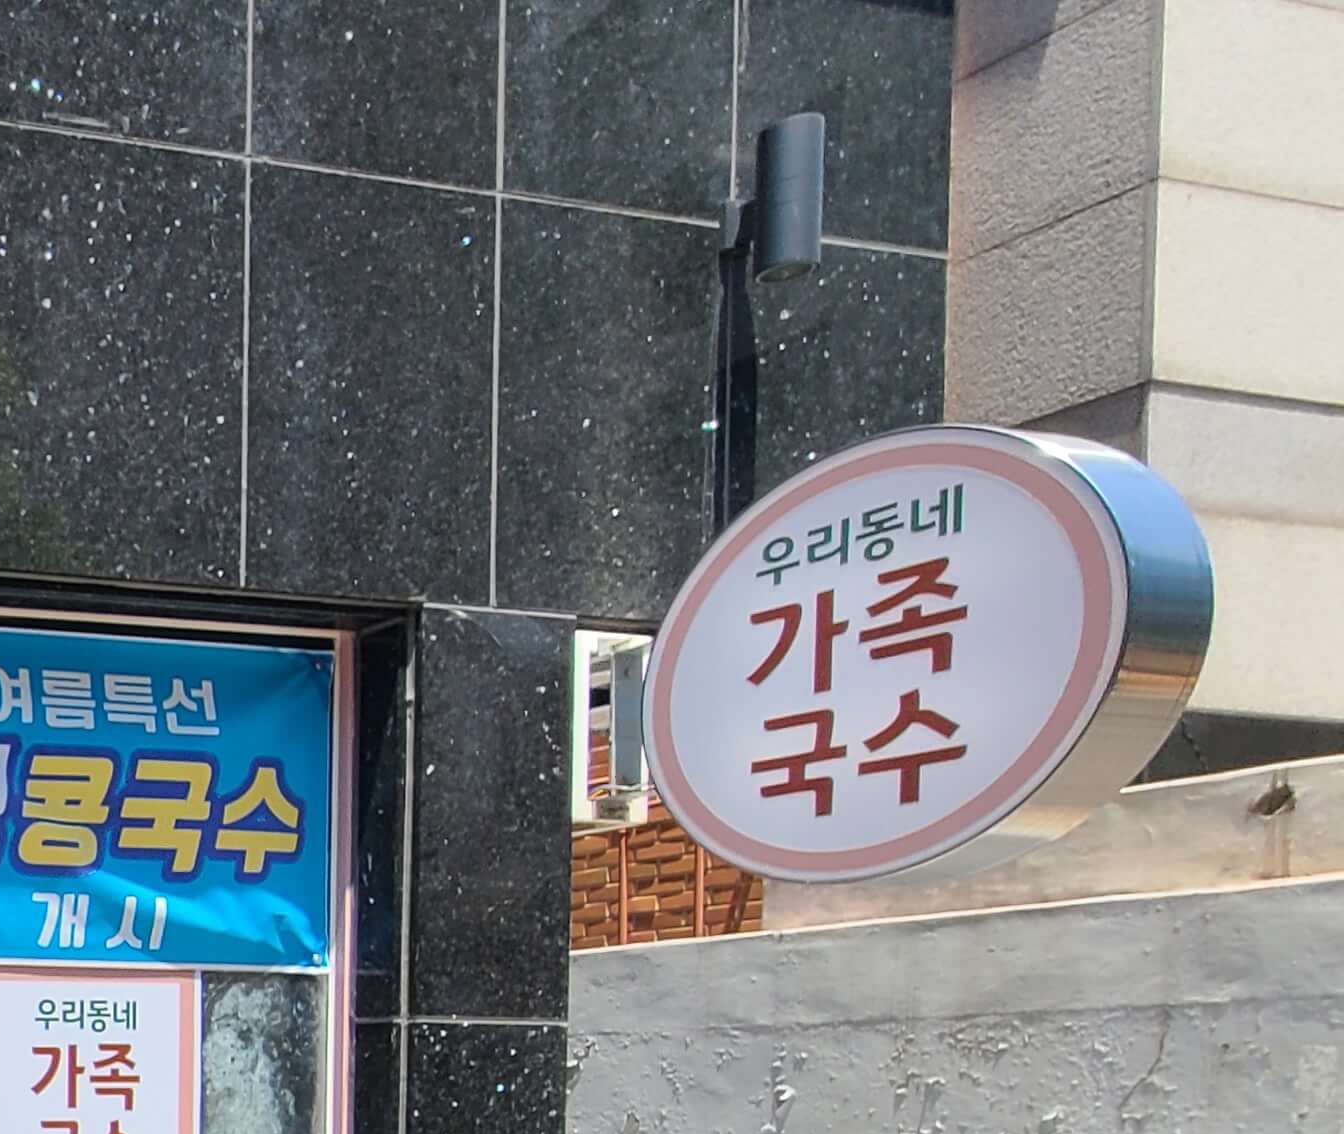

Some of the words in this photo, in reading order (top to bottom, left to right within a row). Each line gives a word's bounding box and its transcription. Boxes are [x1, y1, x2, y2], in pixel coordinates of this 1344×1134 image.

[756, 483, 963, 585] 우리동네
[746, 556, 968, 693] 가족
[751, 689, 968, 817] 국수
[35, 999, 137, 1033] 우리동네
[31, 1043, 141, 1111] 가족
